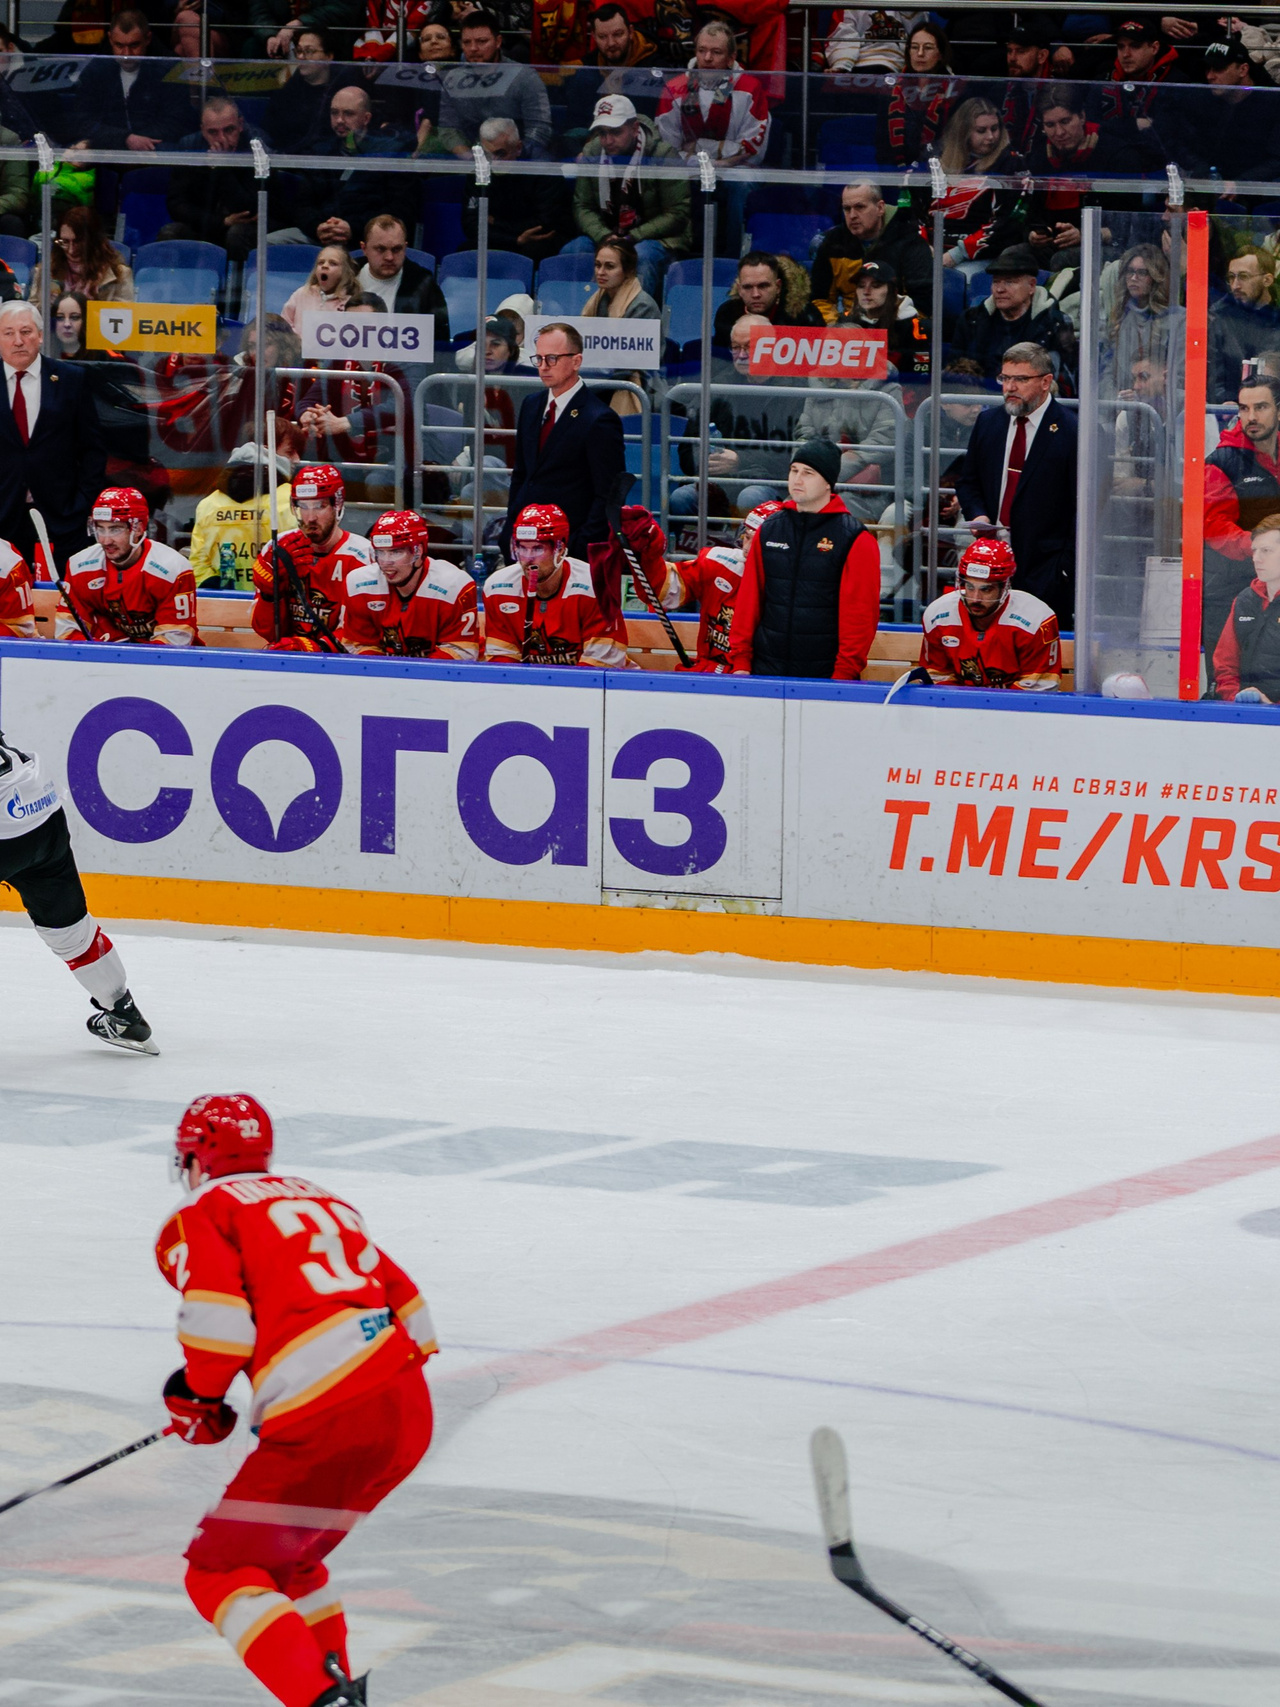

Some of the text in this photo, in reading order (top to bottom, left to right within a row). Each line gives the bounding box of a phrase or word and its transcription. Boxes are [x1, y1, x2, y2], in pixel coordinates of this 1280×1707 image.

[138, 319, 203, 337] БАНК
[583, 334, 654, 352] ПРОМБАНК
[752, 336, 886, 368] FONBET
[216, 509, 266, 522] SAFETY
[330, 559, 343, 582] A
[173, 592, 196, 619] 91
[887, 767, 1279, 805] МЫ ВСЕГДА НА СВЯЗИ #REDSTAR
[239, 1119, 262, 1139] 32
